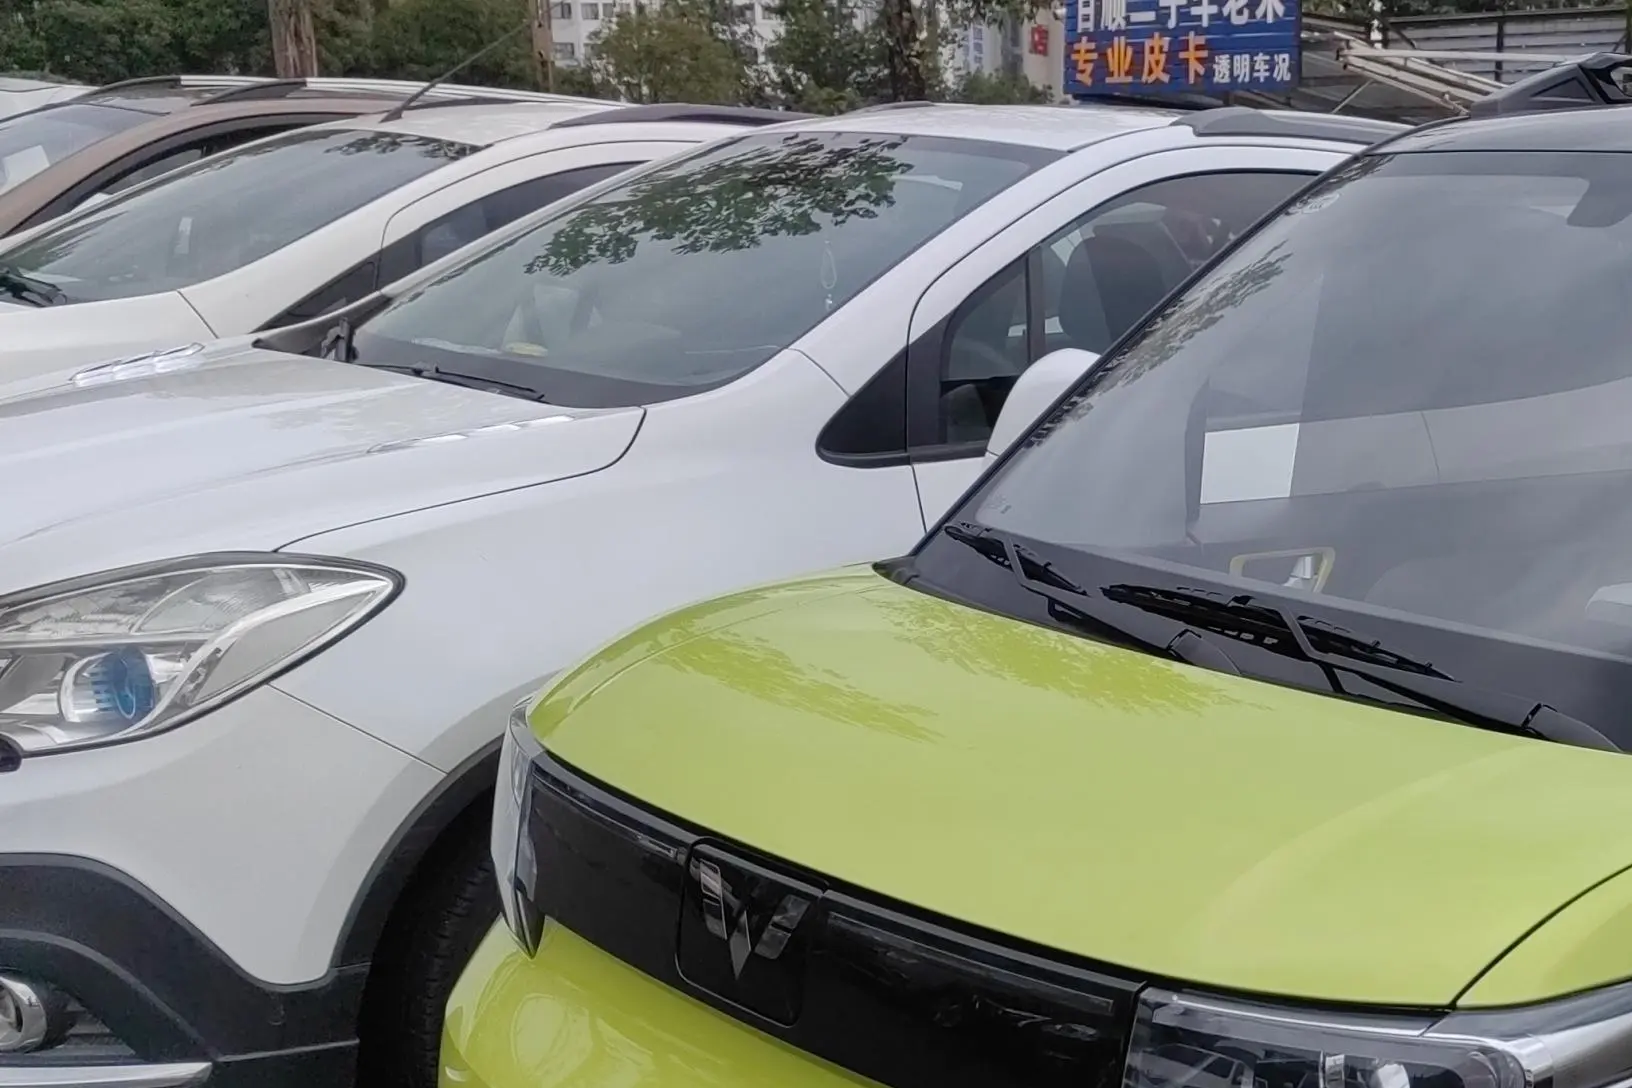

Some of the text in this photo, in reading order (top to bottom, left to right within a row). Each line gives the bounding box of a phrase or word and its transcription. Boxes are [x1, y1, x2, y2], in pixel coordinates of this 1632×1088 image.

[1071, 31, 1291, 87] 专业皮卡 透明车况
